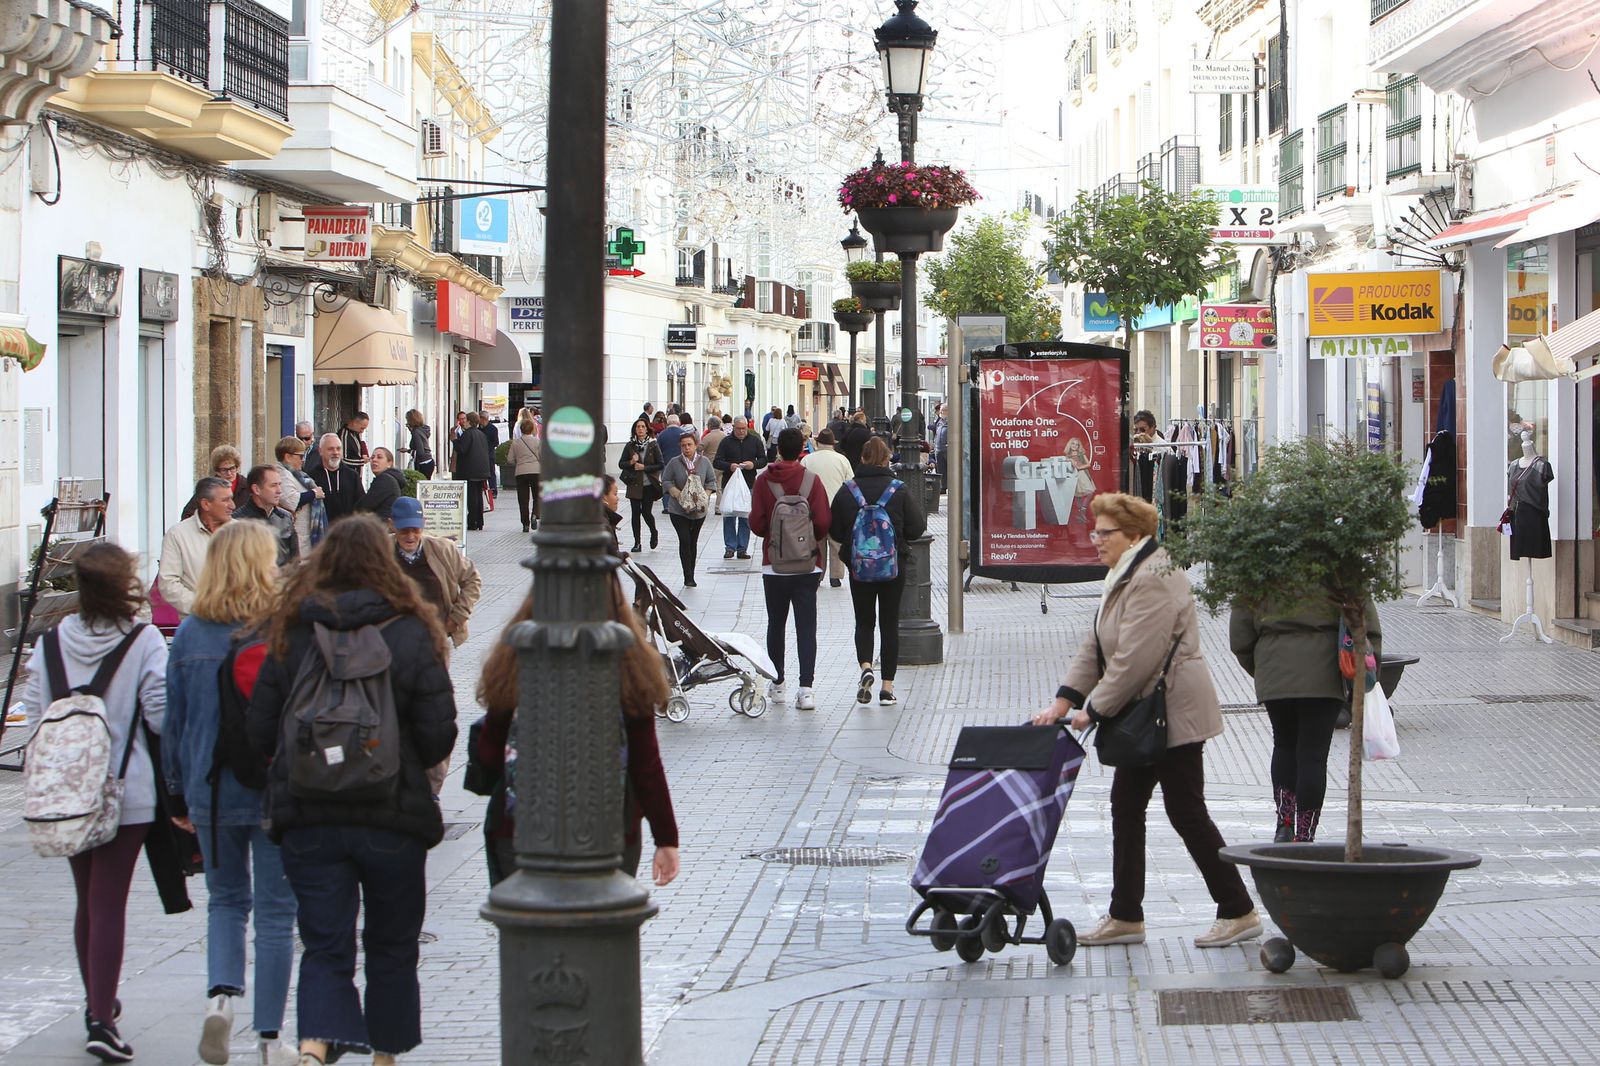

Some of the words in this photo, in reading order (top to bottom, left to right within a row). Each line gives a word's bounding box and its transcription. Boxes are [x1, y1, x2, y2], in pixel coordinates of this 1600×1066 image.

[1192, 64, 1204, 72] Dr.
[1206, 64, 1231, 72] Manuel
[1229, 207, 1248, 226] X
[1258, 207, 1275, 226] 2
[307, 218, 368, 235] PANADERIA
[328, 242, 368, 257] BUTRON
[1358, 283, 1432, 300] PRODUCTOS
[515, 297, 545, 307] DROG
[1371, 302, 1435, 321] Kodak
[513, 321, 545, 331] PERFU
[715, 336, 736, 346] katia
[1320, 337, 1398, 357] MIJITA
[1005, 373, 1040, 382] vodafone
[990, 416, 1034, 427] Vodafone
[1035, 416, 1058, 427] One.
[990, 428, 1004, 438] TV
[1005, 428, 1032, 440] gratis
[1033, 428, 1039, 438] 1
[1040, 428, 1059, 438] año
[990, 441, 1007, 449] con
[1010, 477, 1078, 530] TV
[990, 552, 1018, 561] Ready?
